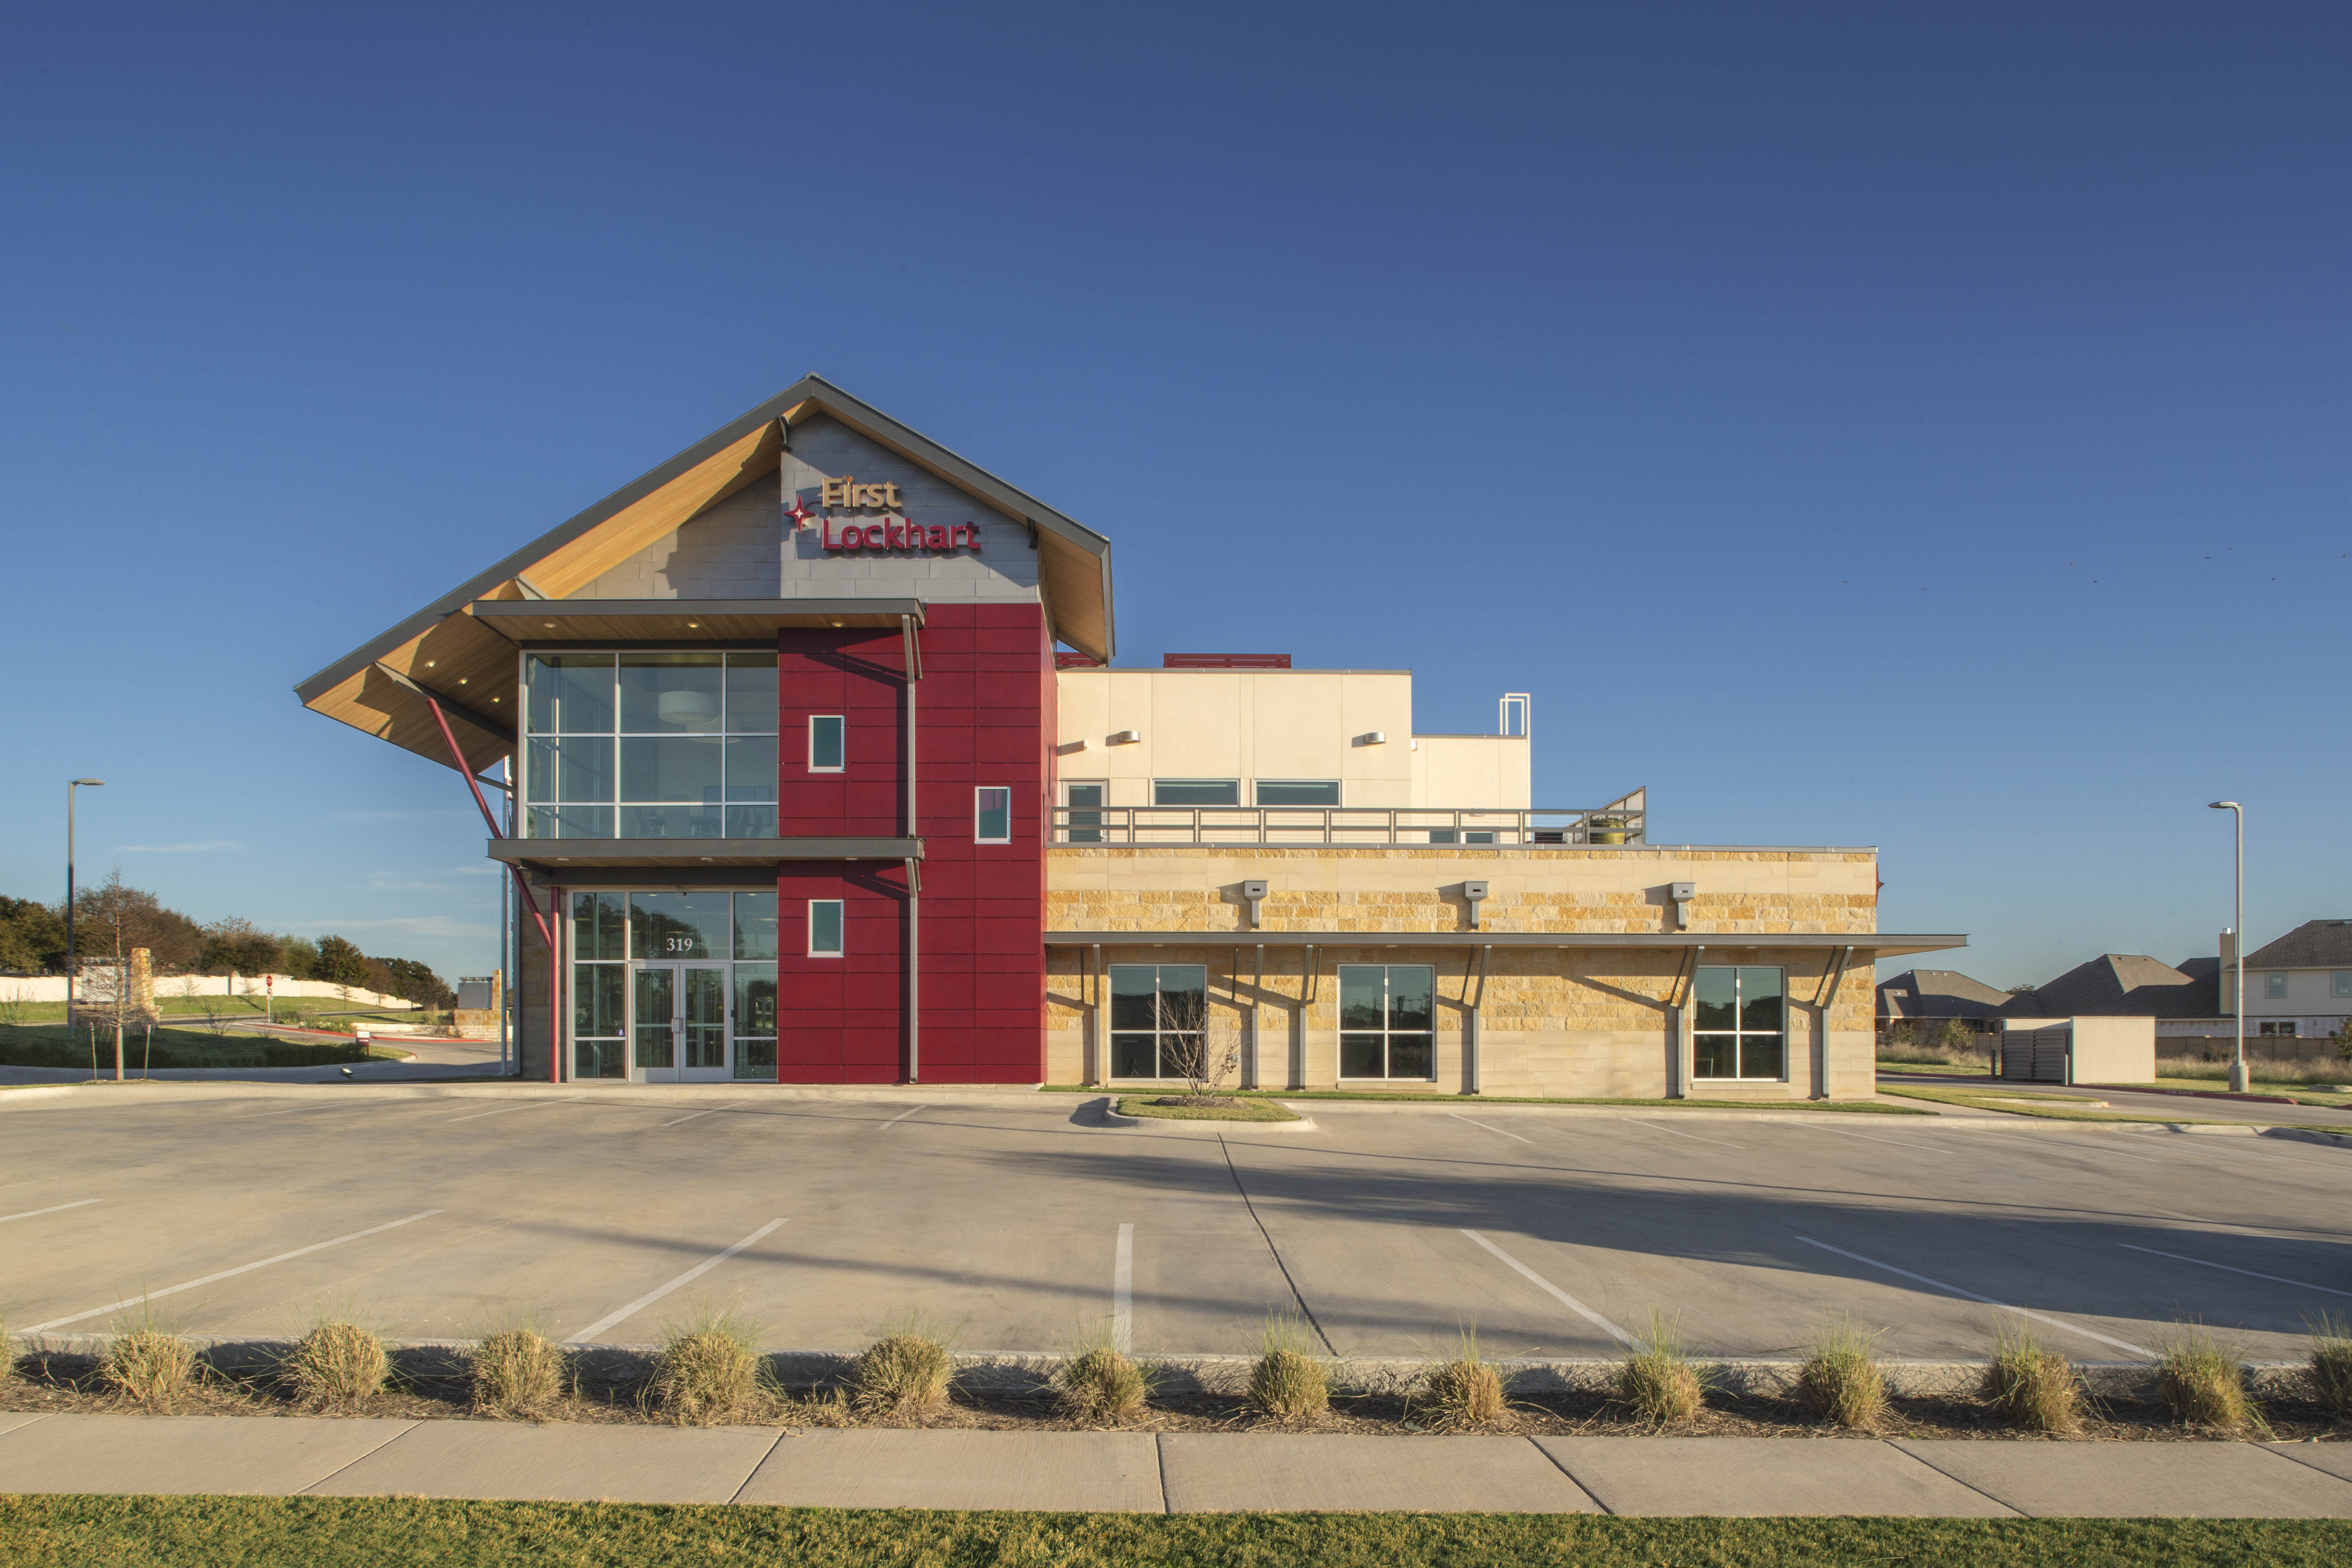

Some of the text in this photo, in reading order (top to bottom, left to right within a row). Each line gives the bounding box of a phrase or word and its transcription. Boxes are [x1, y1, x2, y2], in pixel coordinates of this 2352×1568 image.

[822, 474, 902, 509] First
[822, 517, 981, 549] Lockhart
[666, 938, 693, 951] 319
